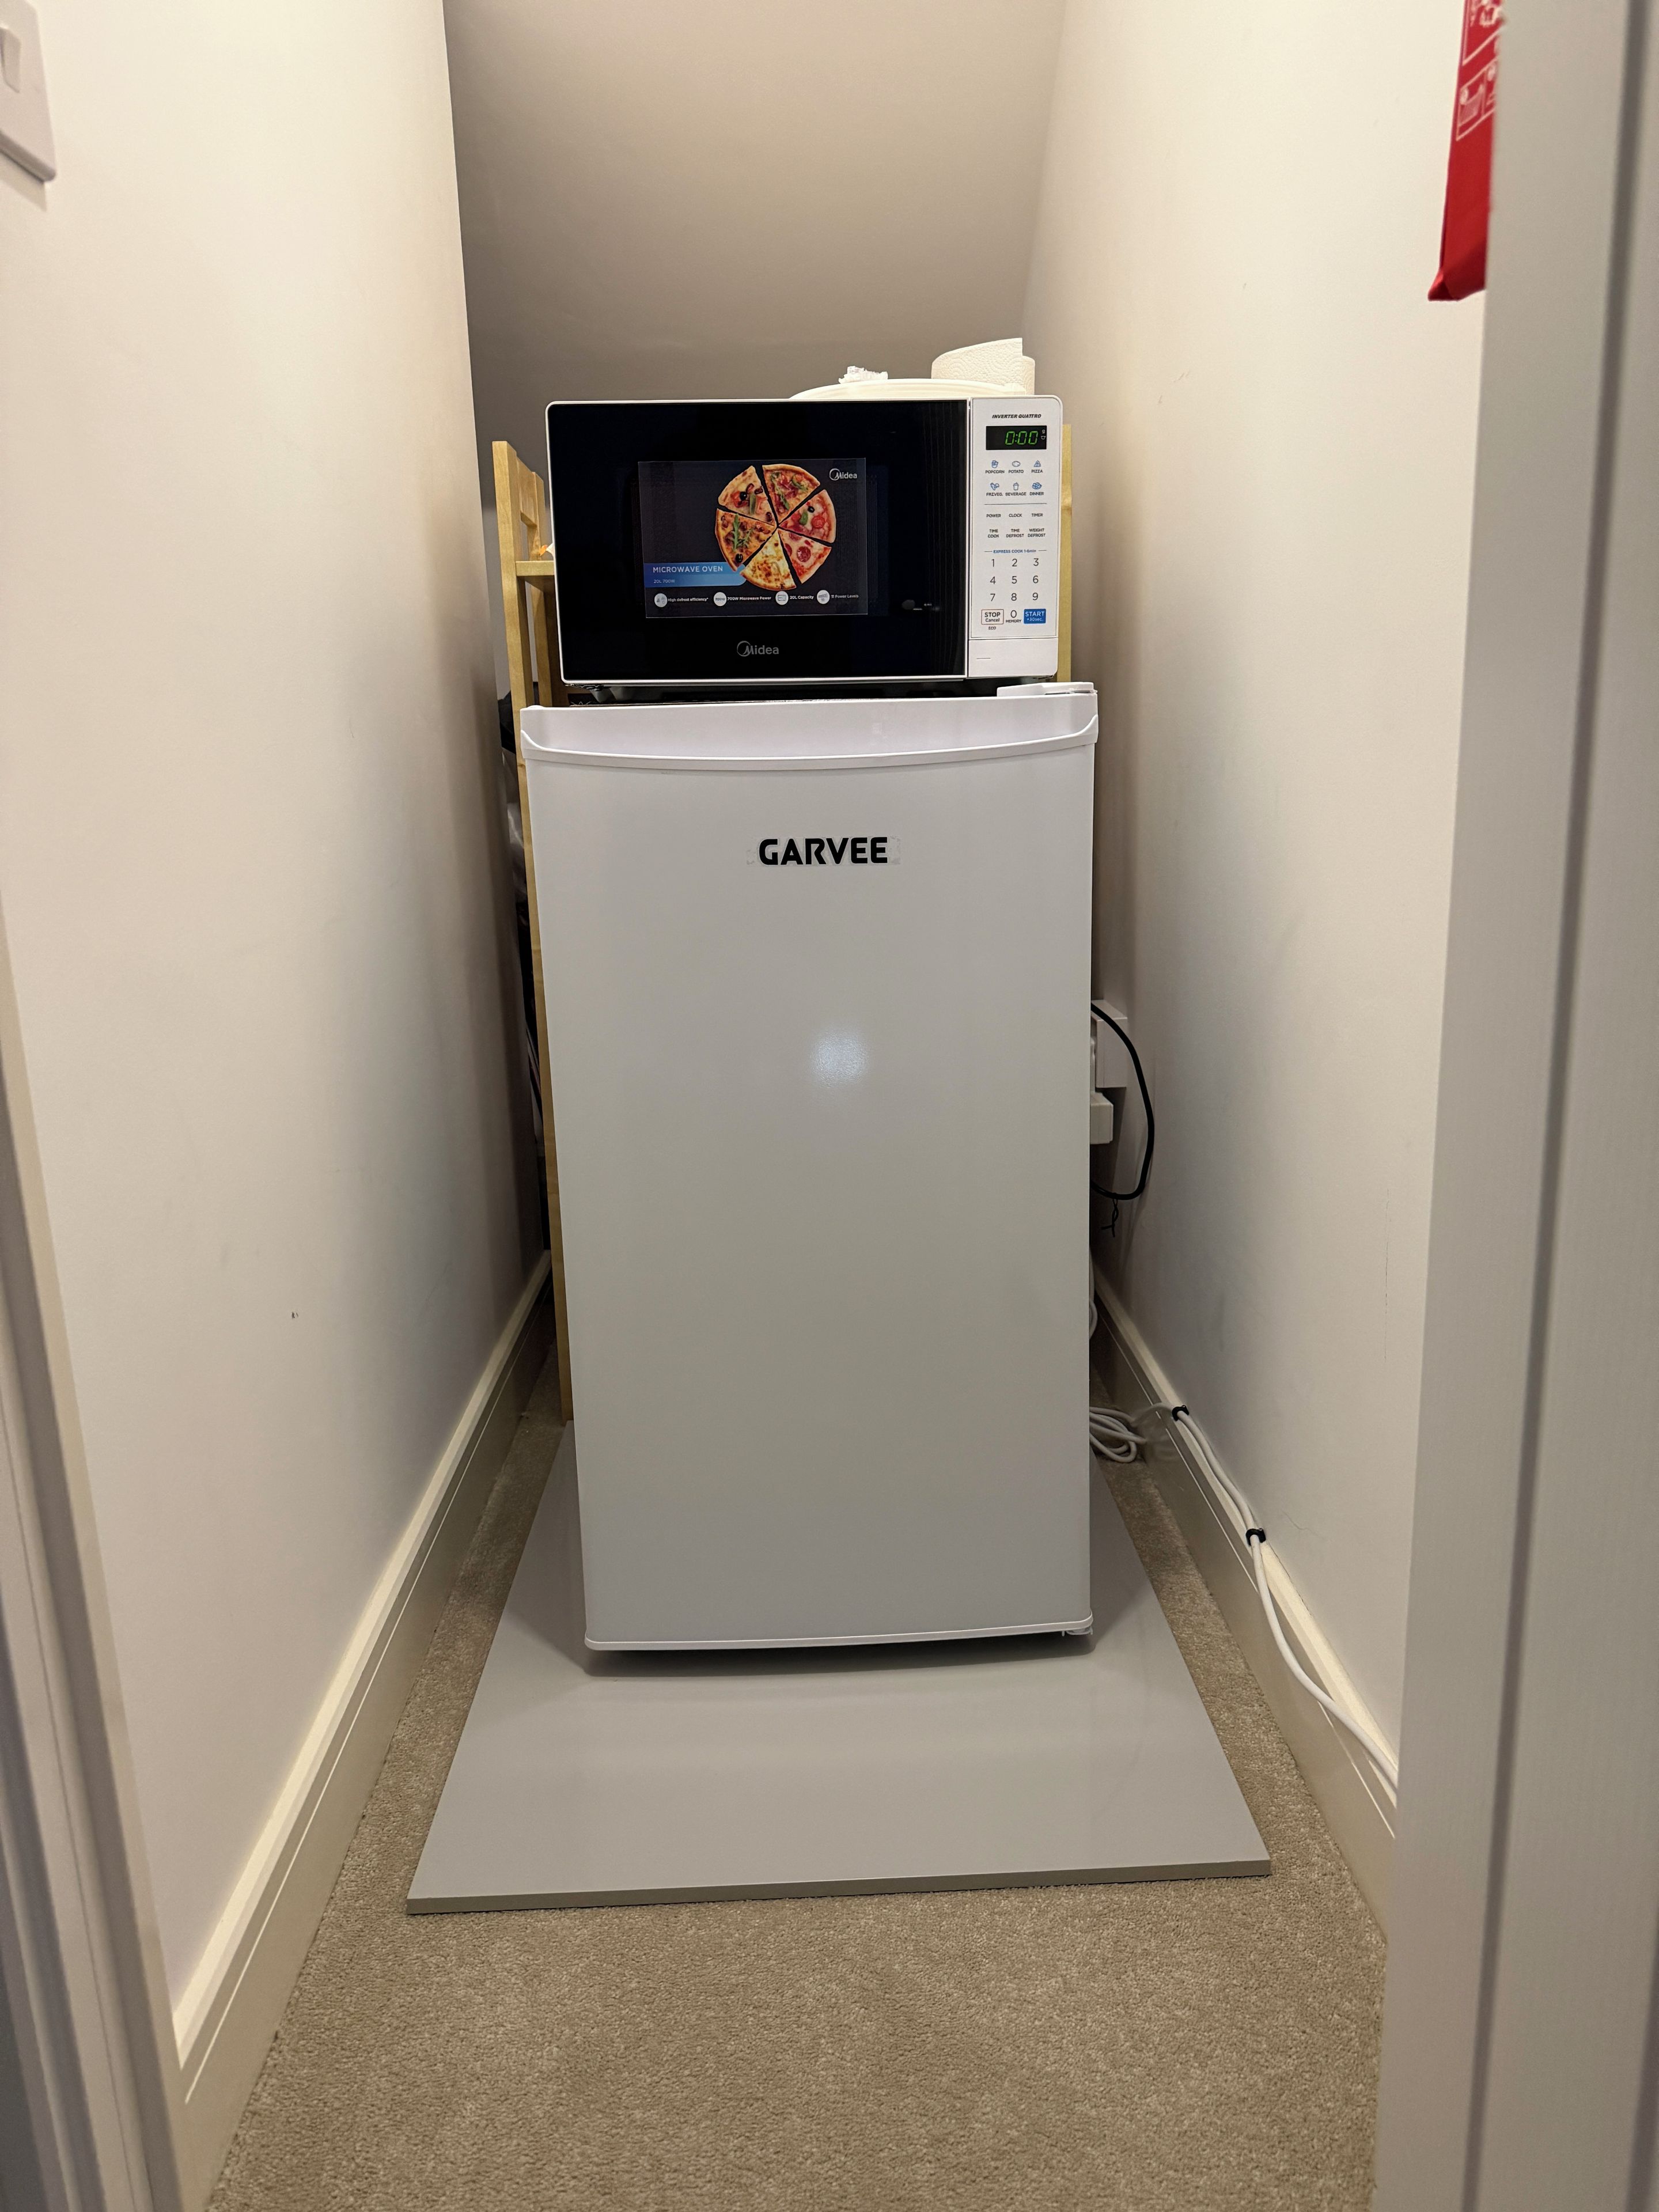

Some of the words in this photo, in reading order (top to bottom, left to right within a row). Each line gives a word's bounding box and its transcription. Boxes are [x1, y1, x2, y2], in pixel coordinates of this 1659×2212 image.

[1005, 431, 1039, 445] 0:00
[829, 468, 858, 481] Midea
[991, 558, 995, 567] 1
[1012, 558, 1018, 567] 2
[1033, 558, 1039, 566] 3
[990, 576, 996, 585] 4
[1012, 576, 1017, 584] 5
[1033, 575, 1039, 584] 6
[990, 593, 995, 601] 7
[1011, 593, 1017, 601] 8
[1032, 592, 1039, 601] 9
[1010, 609, 1017, 618] 0
[737, 641, 779, 657] Midea
[759, 837, 888, 865] GARVEE
